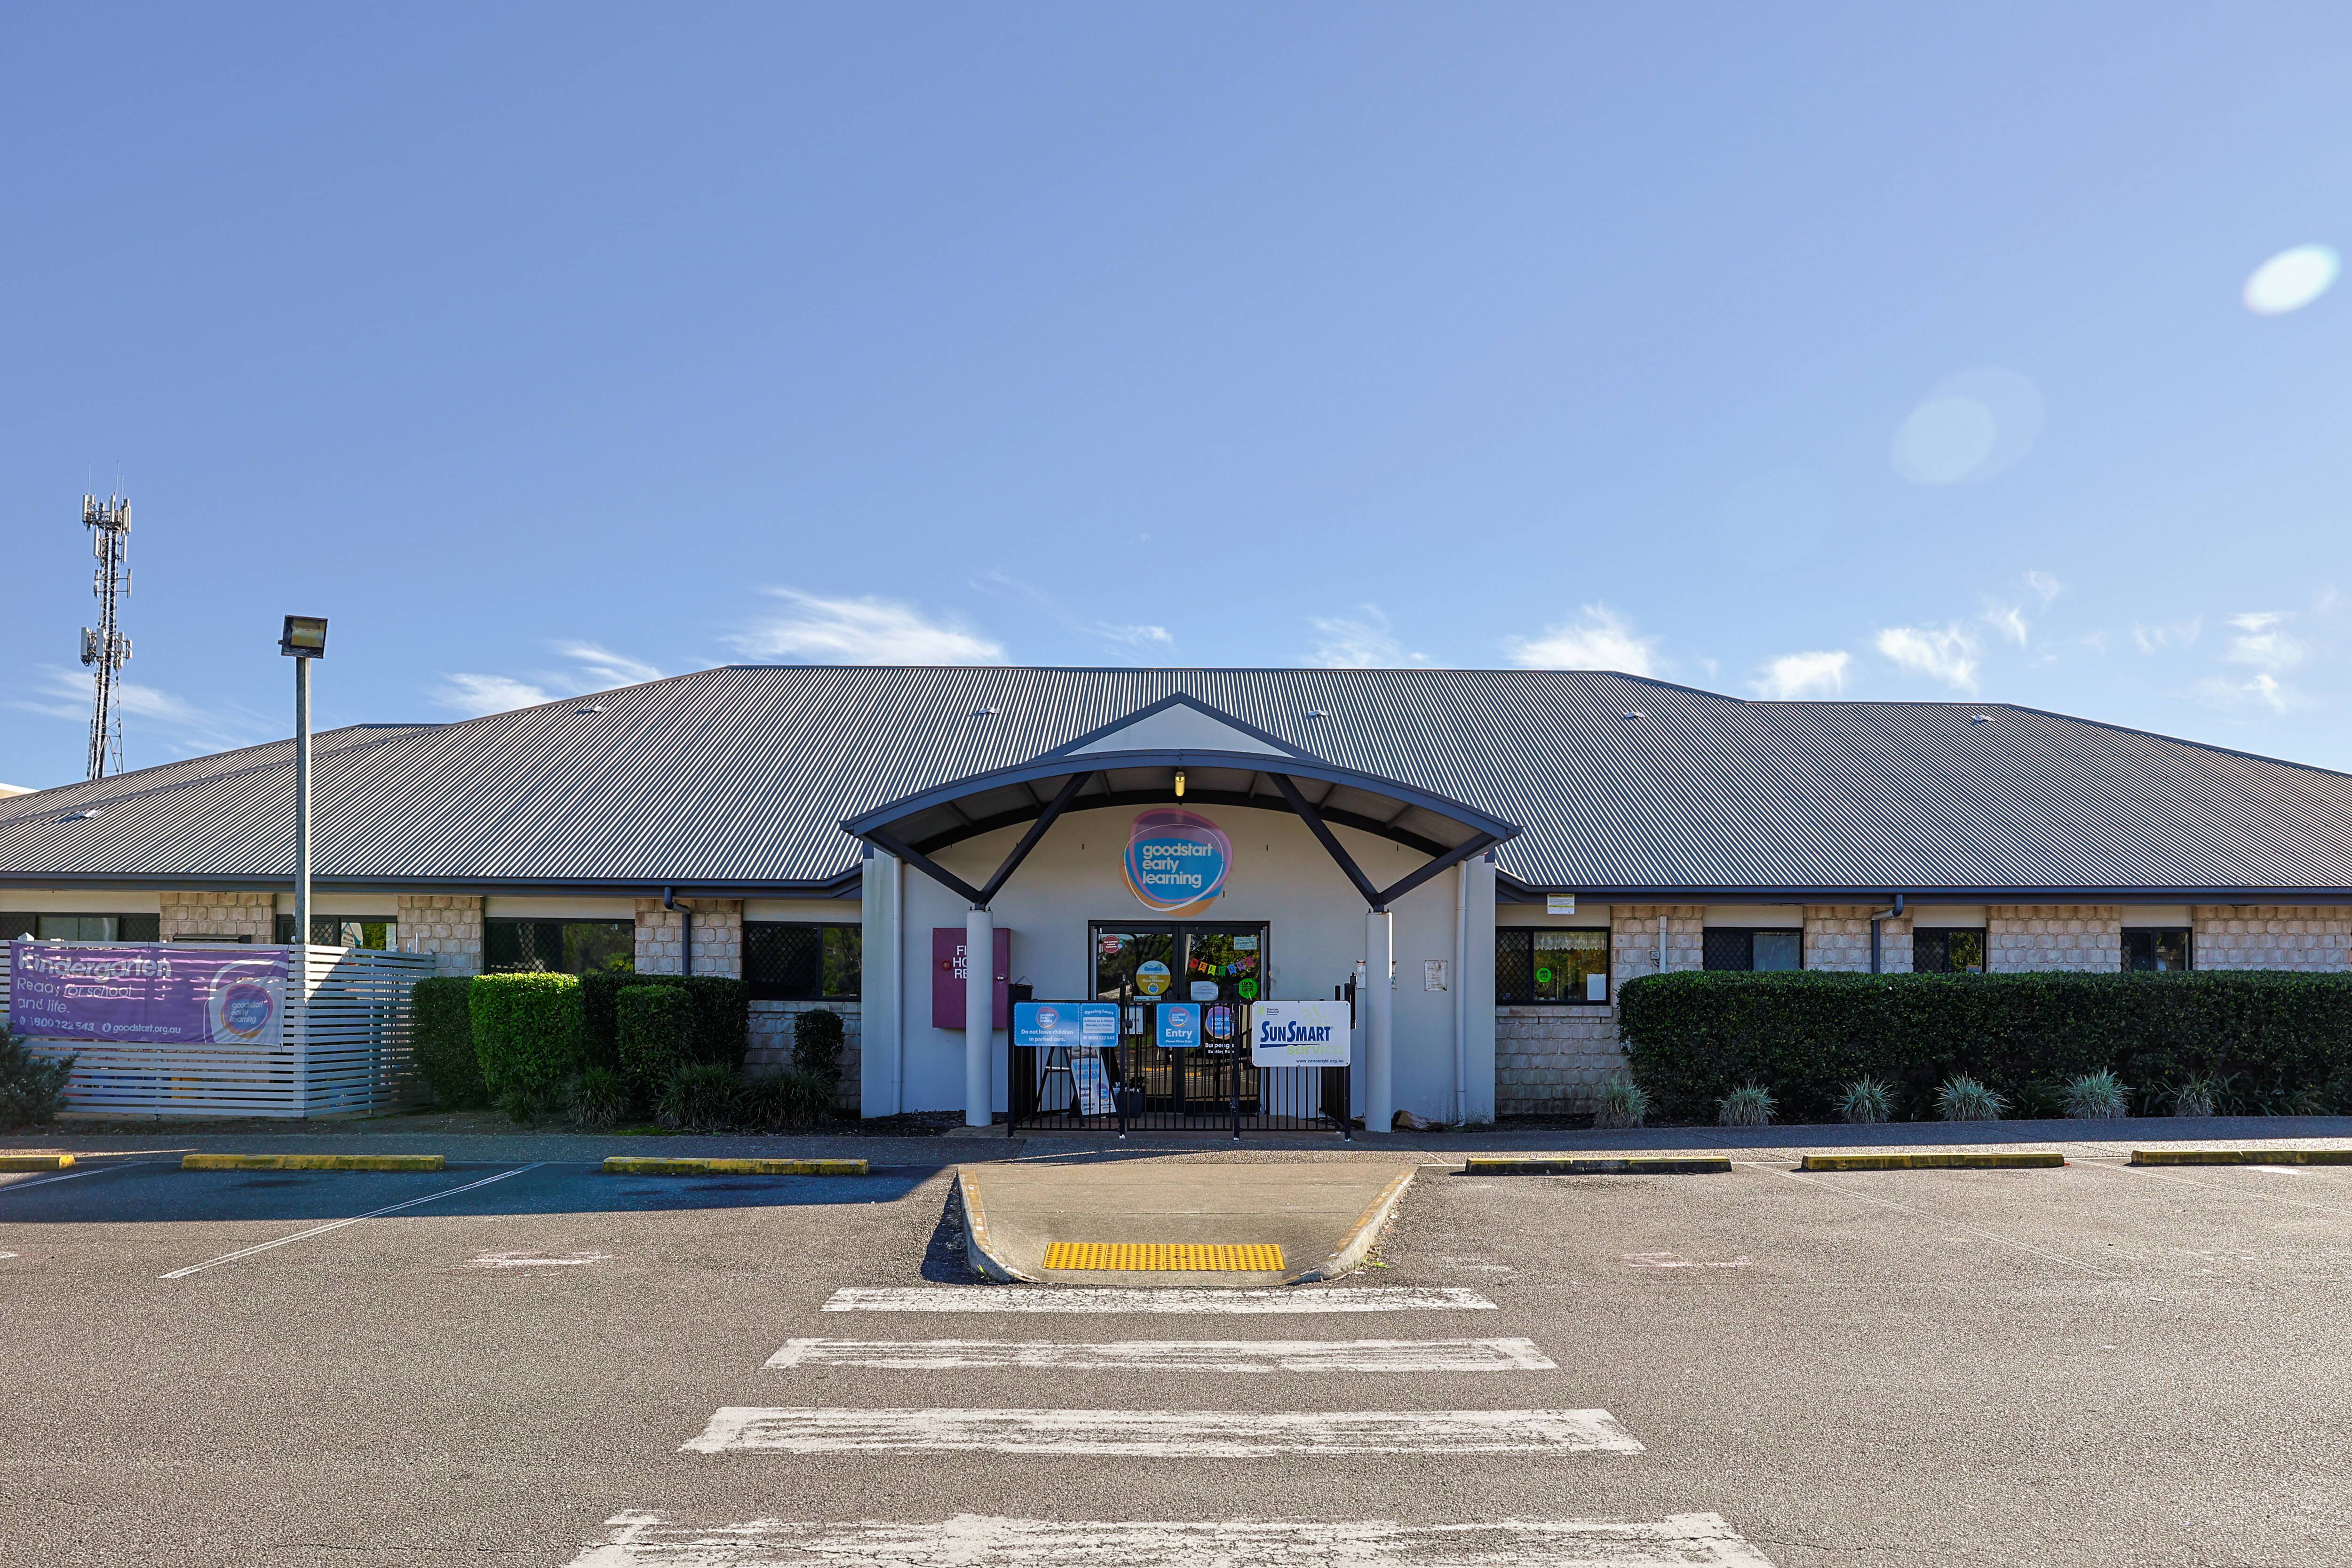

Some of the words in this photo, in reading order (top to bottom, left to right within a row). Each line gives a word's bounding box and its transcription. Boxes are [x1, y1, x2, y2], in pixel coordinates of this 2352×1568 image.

[1143, 843, 1213, 859] goodstart
[1142, 857, 1179, 873] early
[1143, 871, 1201, 888] learning
[18, 949, 171, 983] Kindergarten
[17, 977, 60, 996] Ready
[64, 984, 84, 996] for
[87, 985, 132, 997] school
[18, 998, 44, 1010] and
[47, 999, 69, 1013] life.
[232, 1001, 263, 1010] goodstart
[30, 1017, 54, 1027] 1800
[55, 1019, 73, 1030] 222
[76, 1022, 94, 1031] 543
[113, 1024, 181, 1035] goodstart.org.au
[1166, 1028, 1192, 1039] Entry
[1287, 1043, 1344, 1055] service
